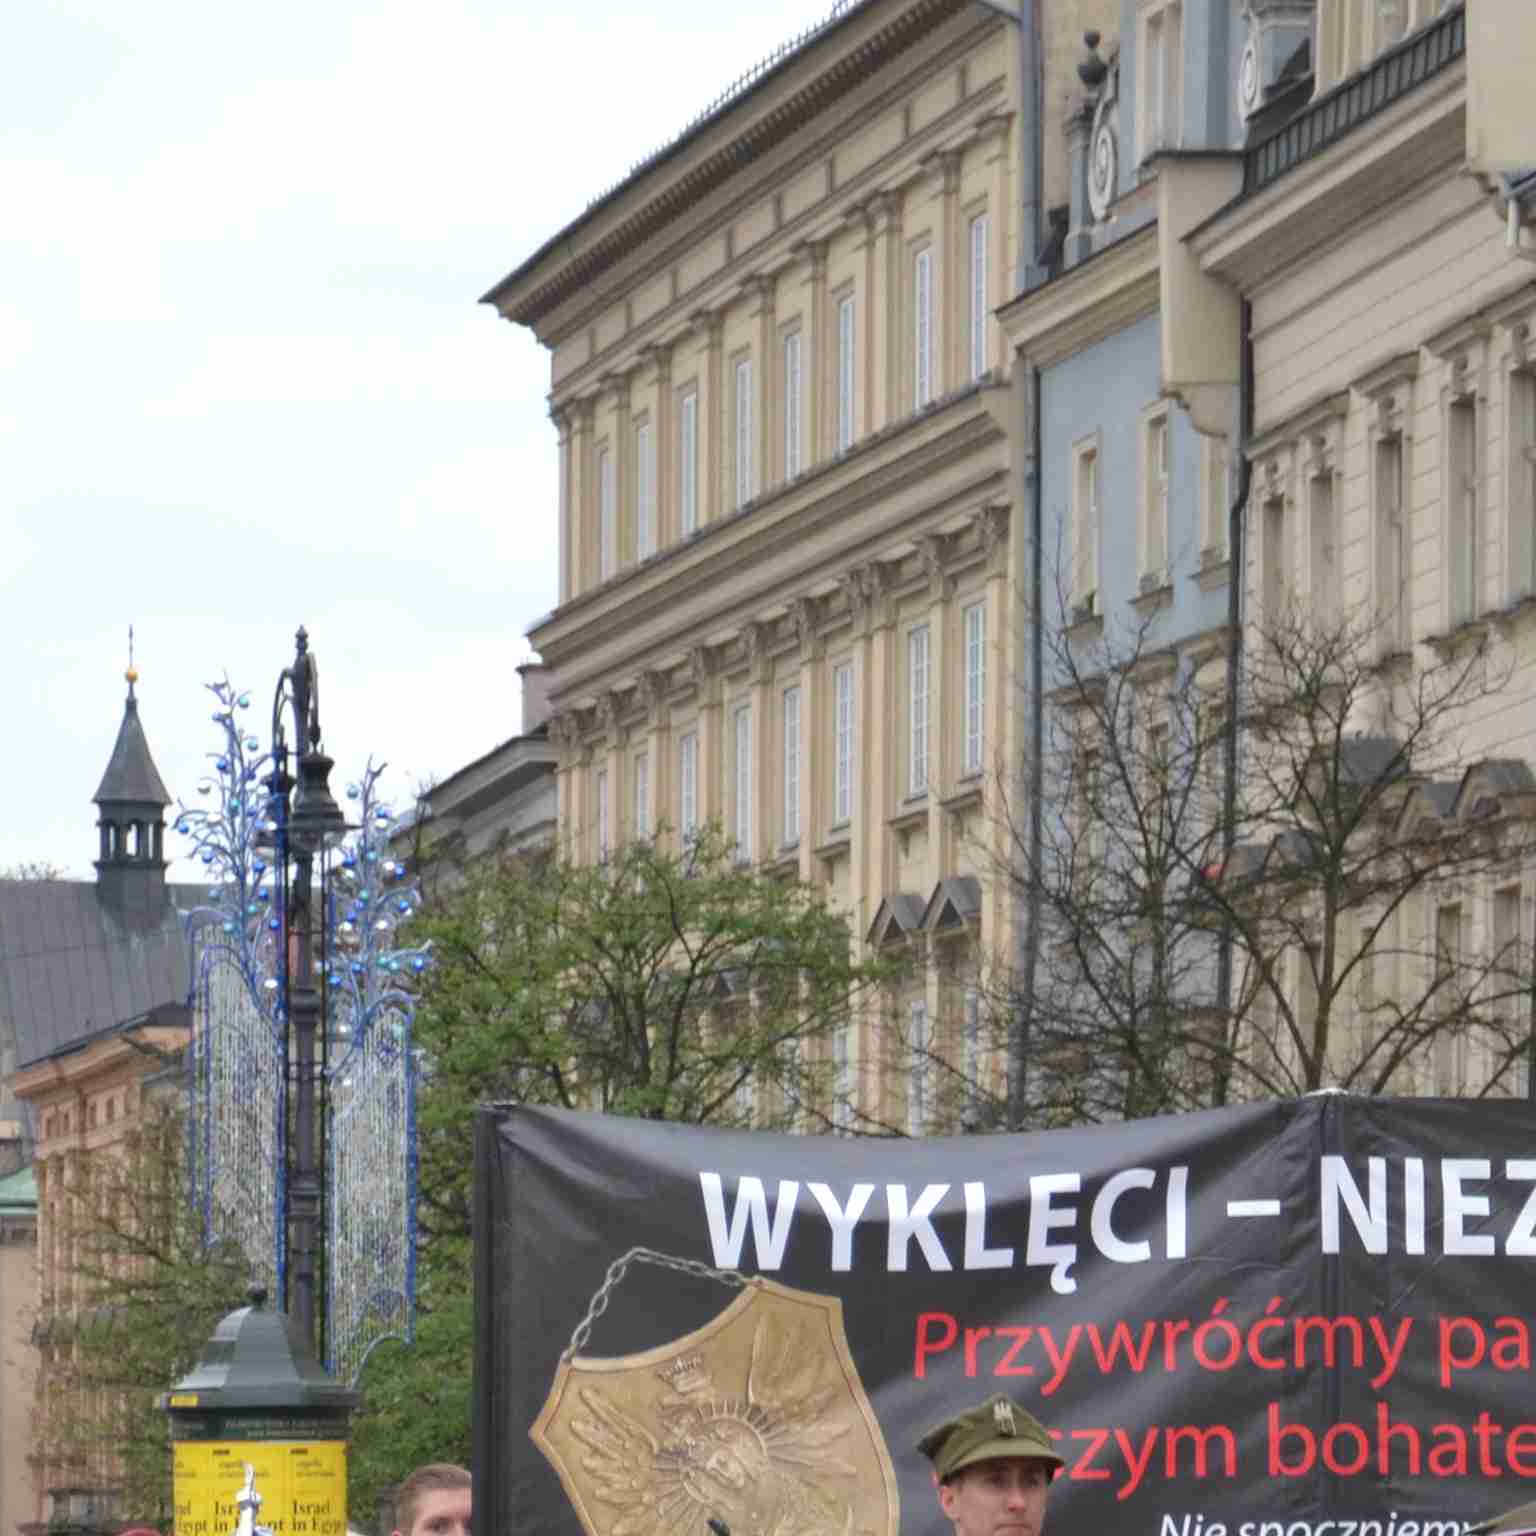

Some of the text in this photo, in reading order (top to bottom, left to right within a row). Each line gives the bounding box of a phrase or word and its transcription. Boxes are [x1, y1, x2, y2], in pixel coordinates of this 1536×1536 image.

[699, 1166, 1189, 1294] WYKLĘCI
[914, 1295, 1413, 1397] Przywróćmy
[1048, 1423, 1238, 1500] zym
